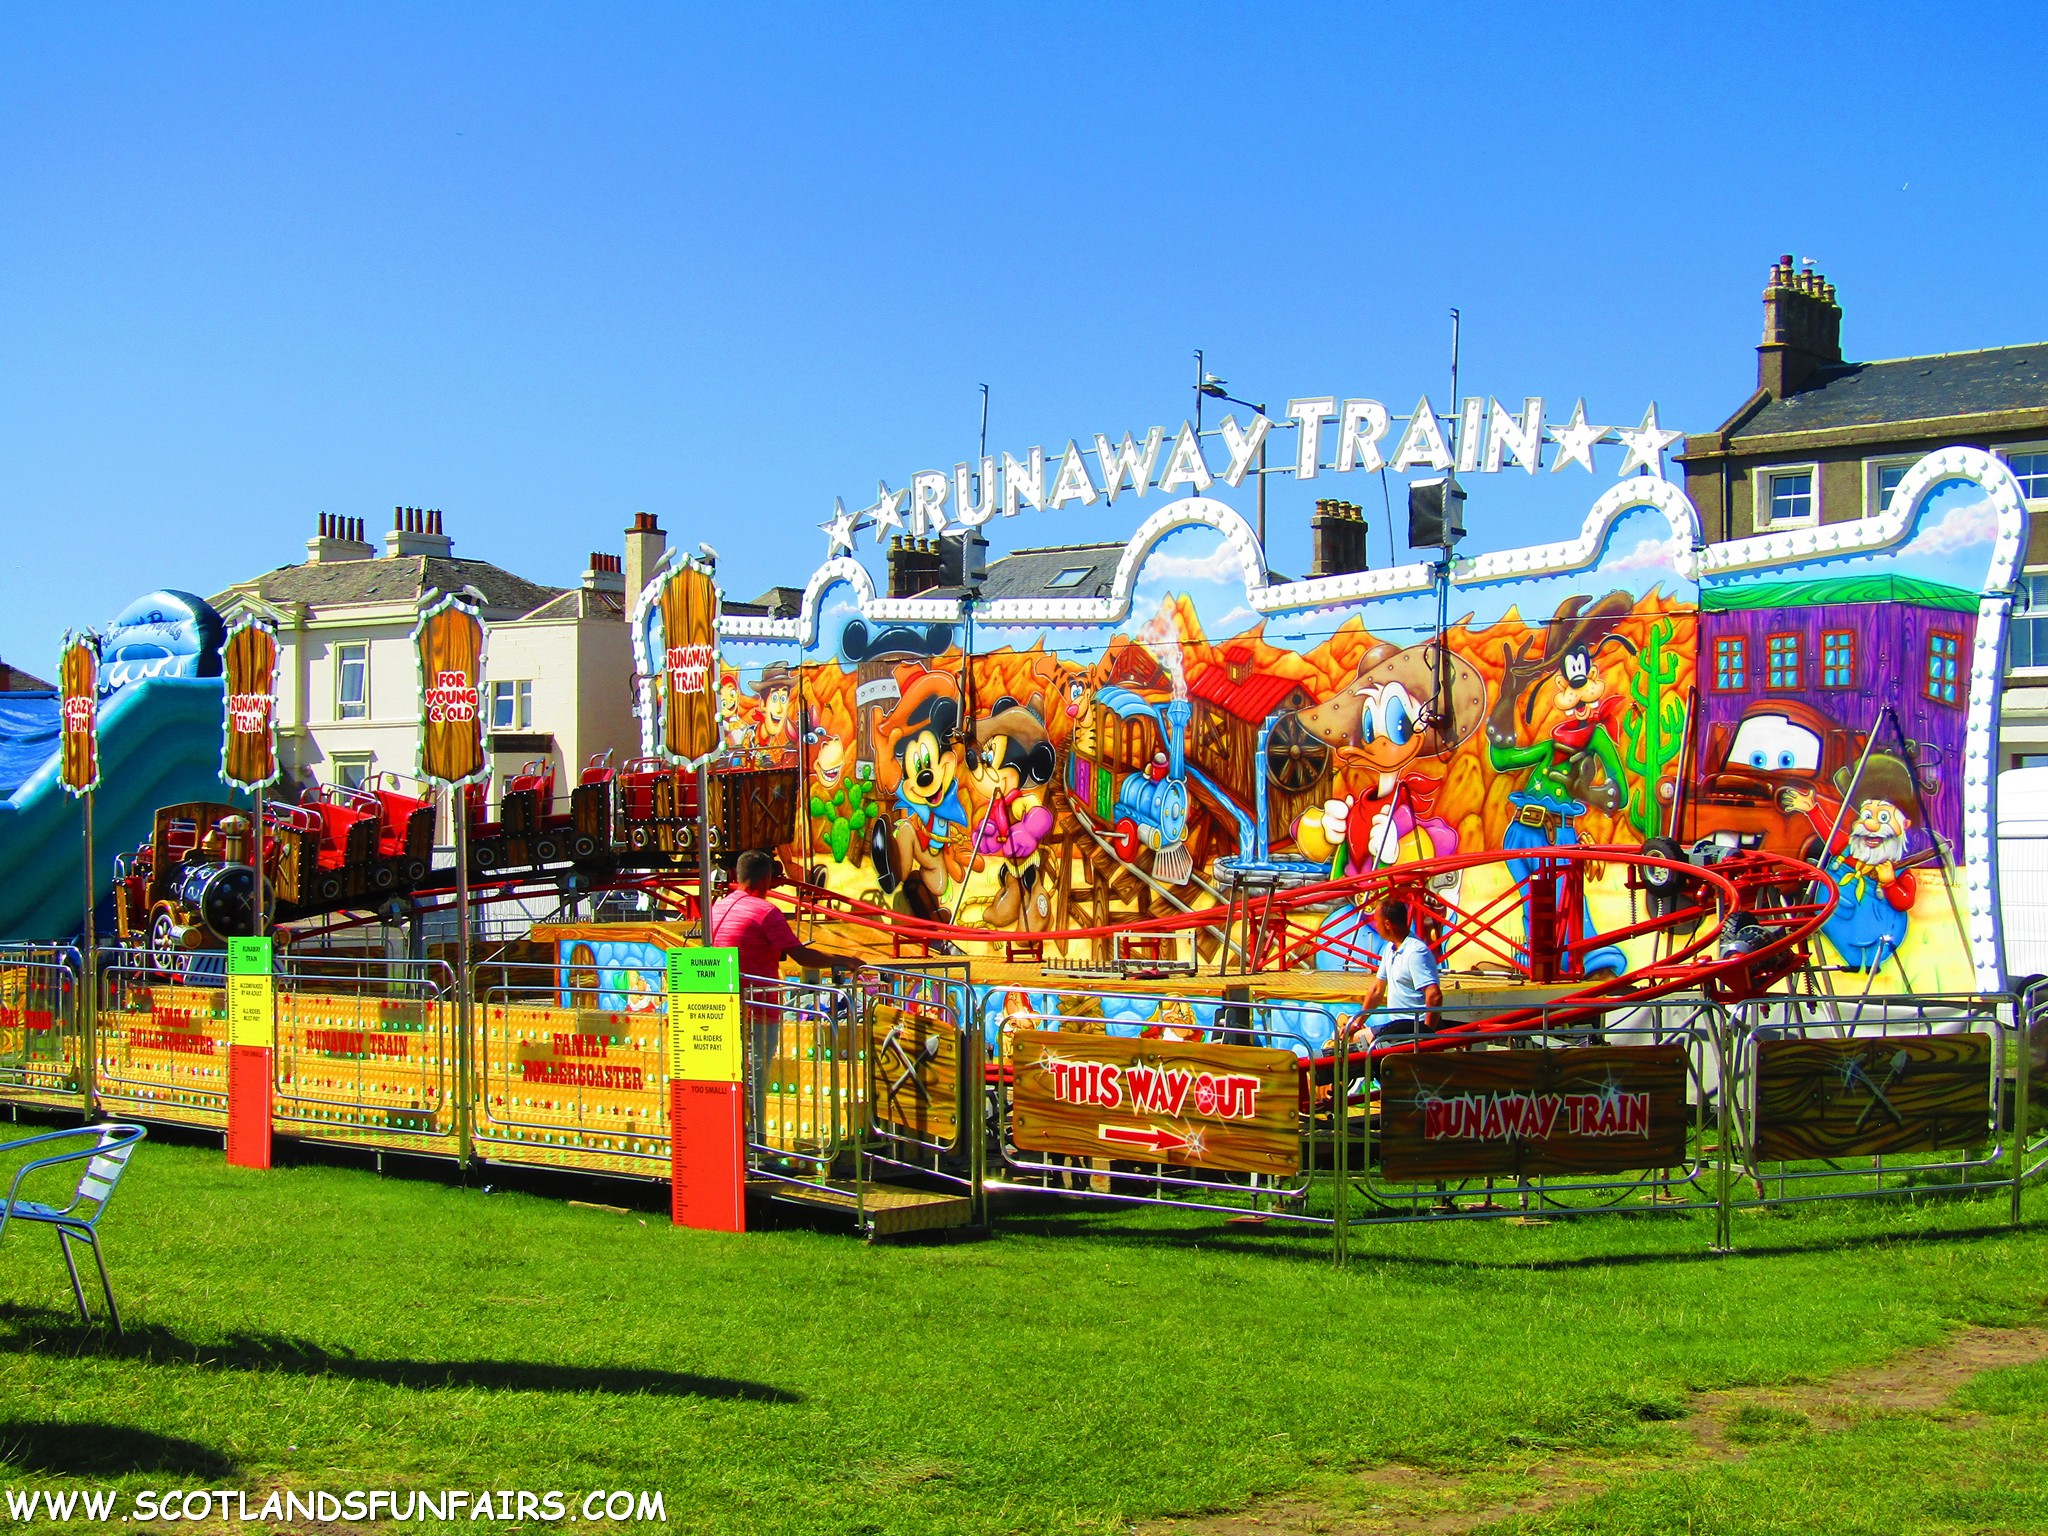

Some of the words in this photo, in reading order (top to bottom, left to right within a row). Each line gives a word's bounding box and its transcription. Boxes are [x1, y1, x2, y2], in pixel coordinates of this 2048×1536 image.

[910, 414, 1272, 535] RUNAWAY
[1286, 395, 1546, 478] TRAIN
[667, 644, 712, 671] RUNAWAY
[438, 671, 466, 688] FOR
[675, 670, 705, 693] TRAIN
[65, 696, 94, 717] CRAZY
[229, 693, 271, 716] RUNAWAY
[426, 688, 477, 706] YOUNG
[71, 716, 88, 732] FUN
[236, 713, 263, 733] TRAIN
[430, 706, 445, 722] &
[446, 706, 474, 722] OLD
[690, 958, 721, 967] RUNAWAY
[696, 970, 716, 978] TRAIN
[151, 1005, 190, 1028] FAMILY
[687, 1003, 726, 1011] ACCOMPANIED
[690, 1012, 697, 1020] BY
[130, 1028, 214, 1055] ROLLERCOASTER
[307, 1030, 363, 1053] RUNAWAY
[370, 1033, 408, 1056] TRAIN
[553, 1033, 609, 1058] FAMILY
[522, 1060, 643, 1090] ROLLERCOASTER
[704, 1086, 727, 1094] SMALL!
[1049, 1059, 1123, 1109] THIS
[1126, 1060, 1193, 1118] WAY
[1194, 1072, 1261, 1119] OUT
[1425, 1090, 1562, 1143] RUNAWAY
[1564, 1090, 1649, 1139] TRAIN
